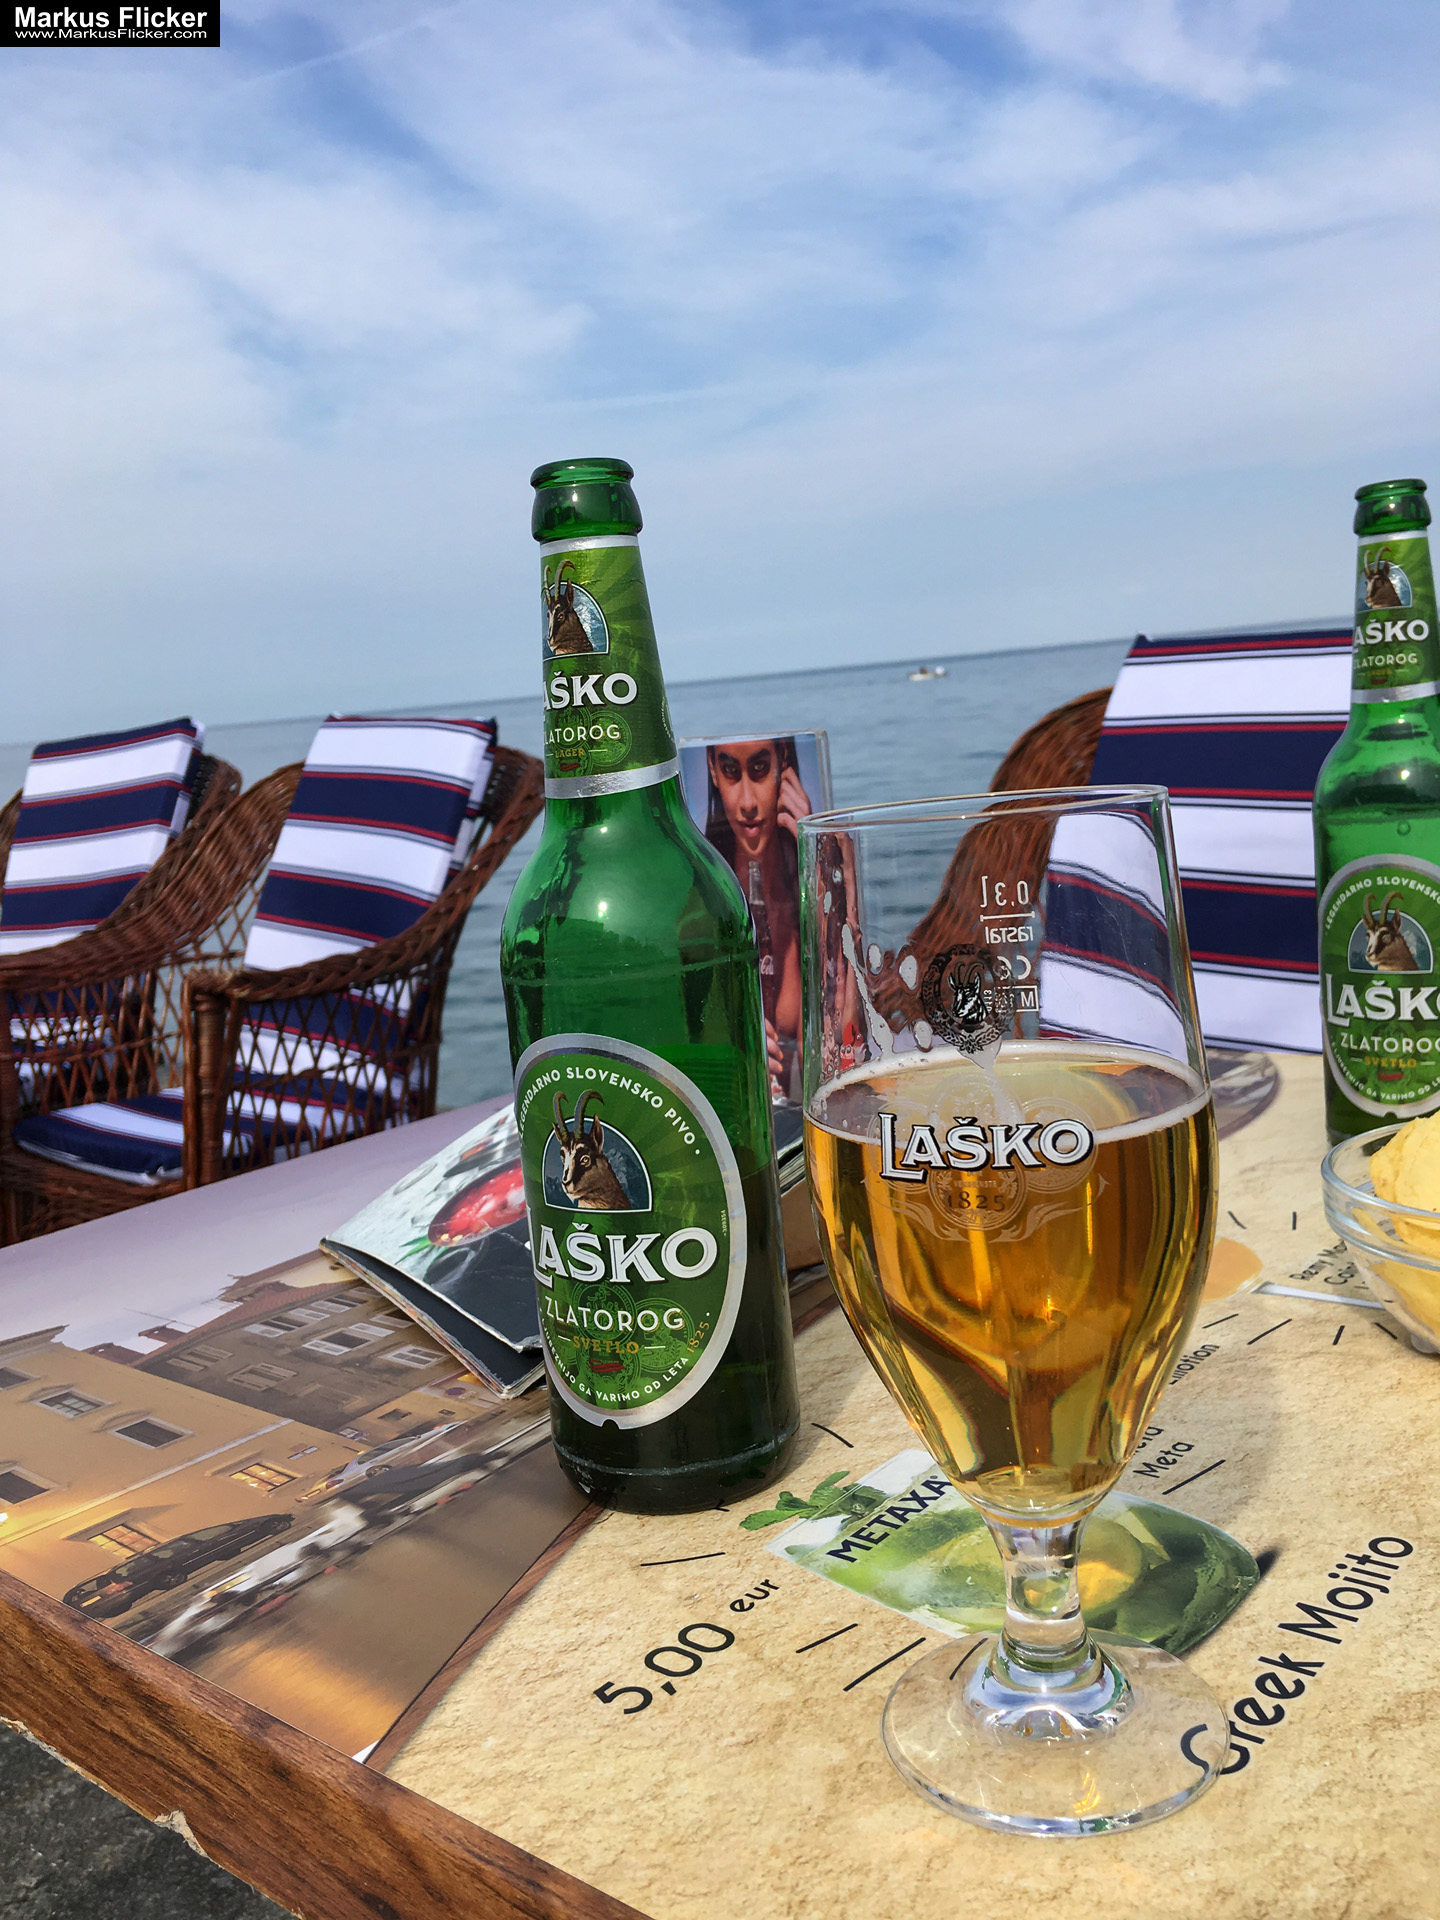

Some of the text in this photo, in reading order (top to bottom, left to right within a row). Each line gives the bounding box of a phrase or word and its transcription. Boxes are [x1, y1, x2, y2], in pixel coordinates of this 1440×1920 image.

[1354, 619, 1430, 647] AŠKO
[1353, 652, 1418, 669] LATOROG
[543, 671, 638, 711] AŠKO
[544, 724, 621, 745] LATOROG
[555, 748, 585, 758] LAGER
[1325, 973, 1440, 1028] LAŠK
[1364, 1056, 1417, 1068] SVETLO
[566, 1066, 663, 1109] SLOVENSKO
[664, 1107, 696, 1145] PIVO
[878, 1112, 1094, 1183] LAŠKO
[947, 1190, 1006, 1212] 1825
[527, 1205, 718, 1289] LAŠKO
[544, 1295, 685, 1331] ZLATOROG
[573, 1335, 640, 1354] SVETLO
[578, 1382, 592, 1396] GA
[596, 1389, 640, 1403] VARIMO
[644, 1380, 661, 1394] OD
[662, 1356, 689, 1382] LETA
[686, 1321, 710, 1353] 1825
[1132, 1441, 1195, 1478] Meta
[1277, 1536, 1414, 1645] Mojito
[593, 1578, 780, 1715] 5,00 eur
